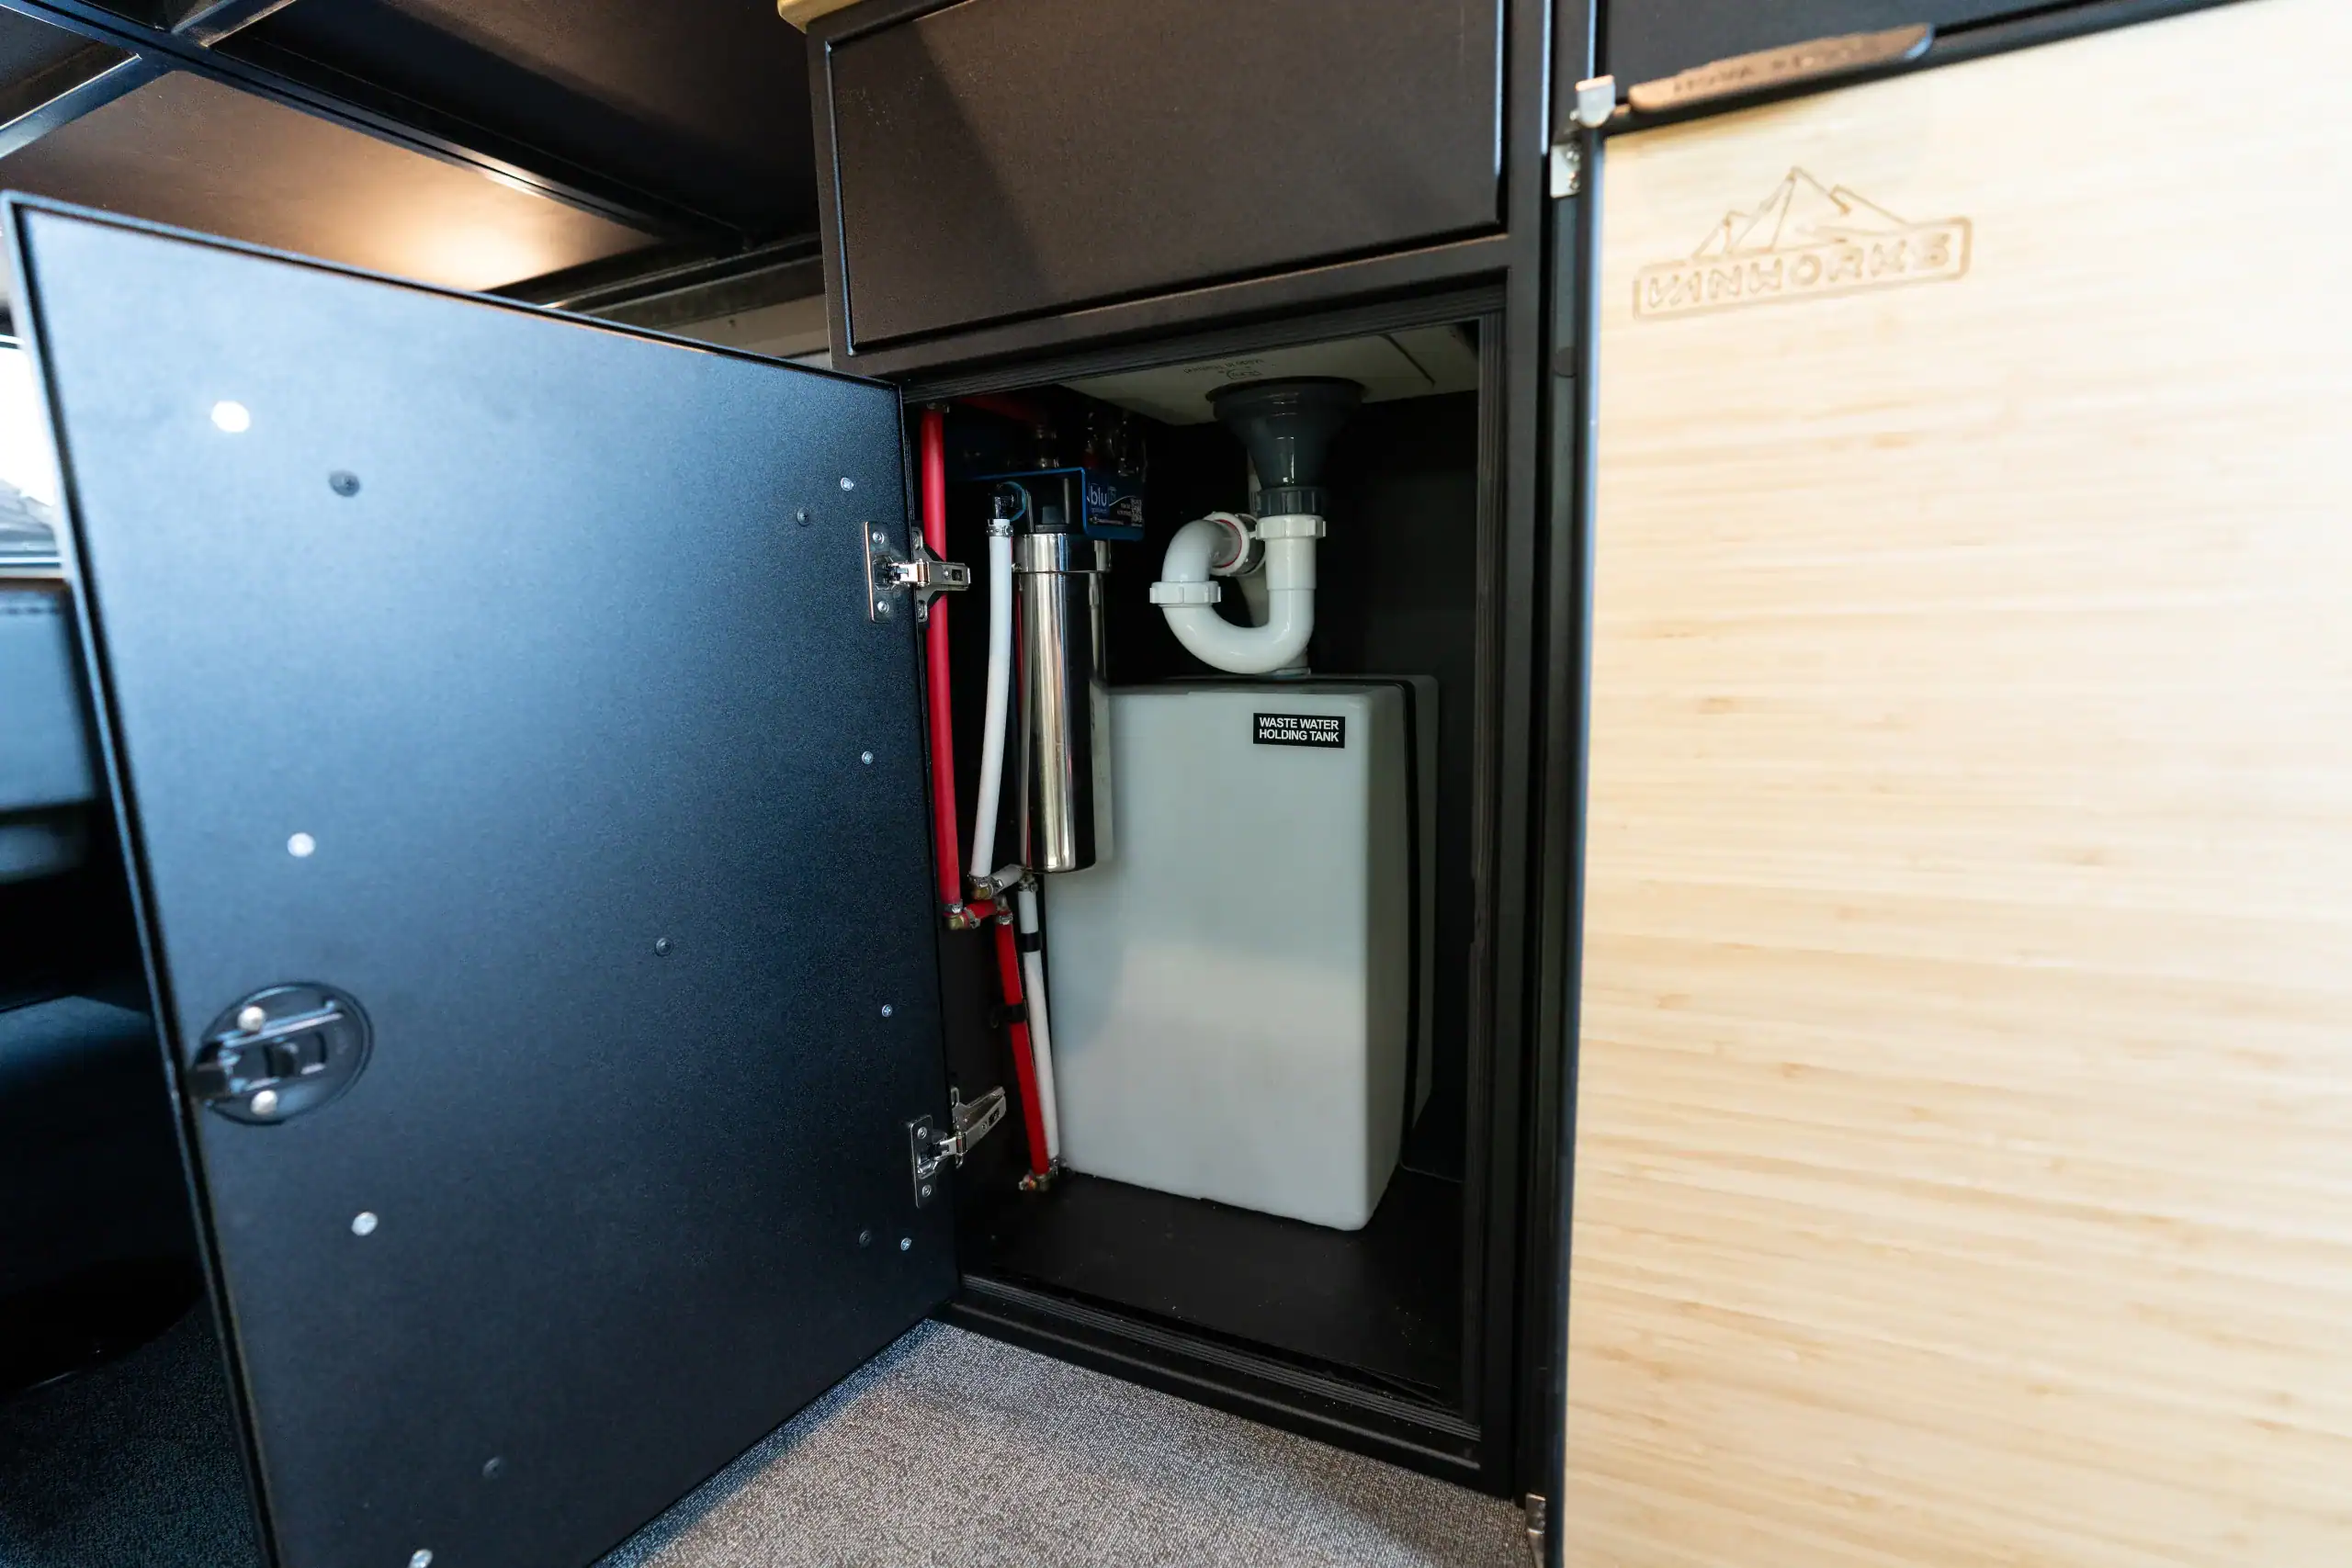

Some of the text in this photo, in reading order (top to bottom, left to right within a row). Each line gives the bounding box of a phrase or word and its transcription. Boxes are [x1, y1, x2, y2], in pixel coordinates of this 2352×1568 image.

[1259, 716, 1340, 730] WASTE WATER
[1259, 728, 1340, 742] HOLDING TANK
